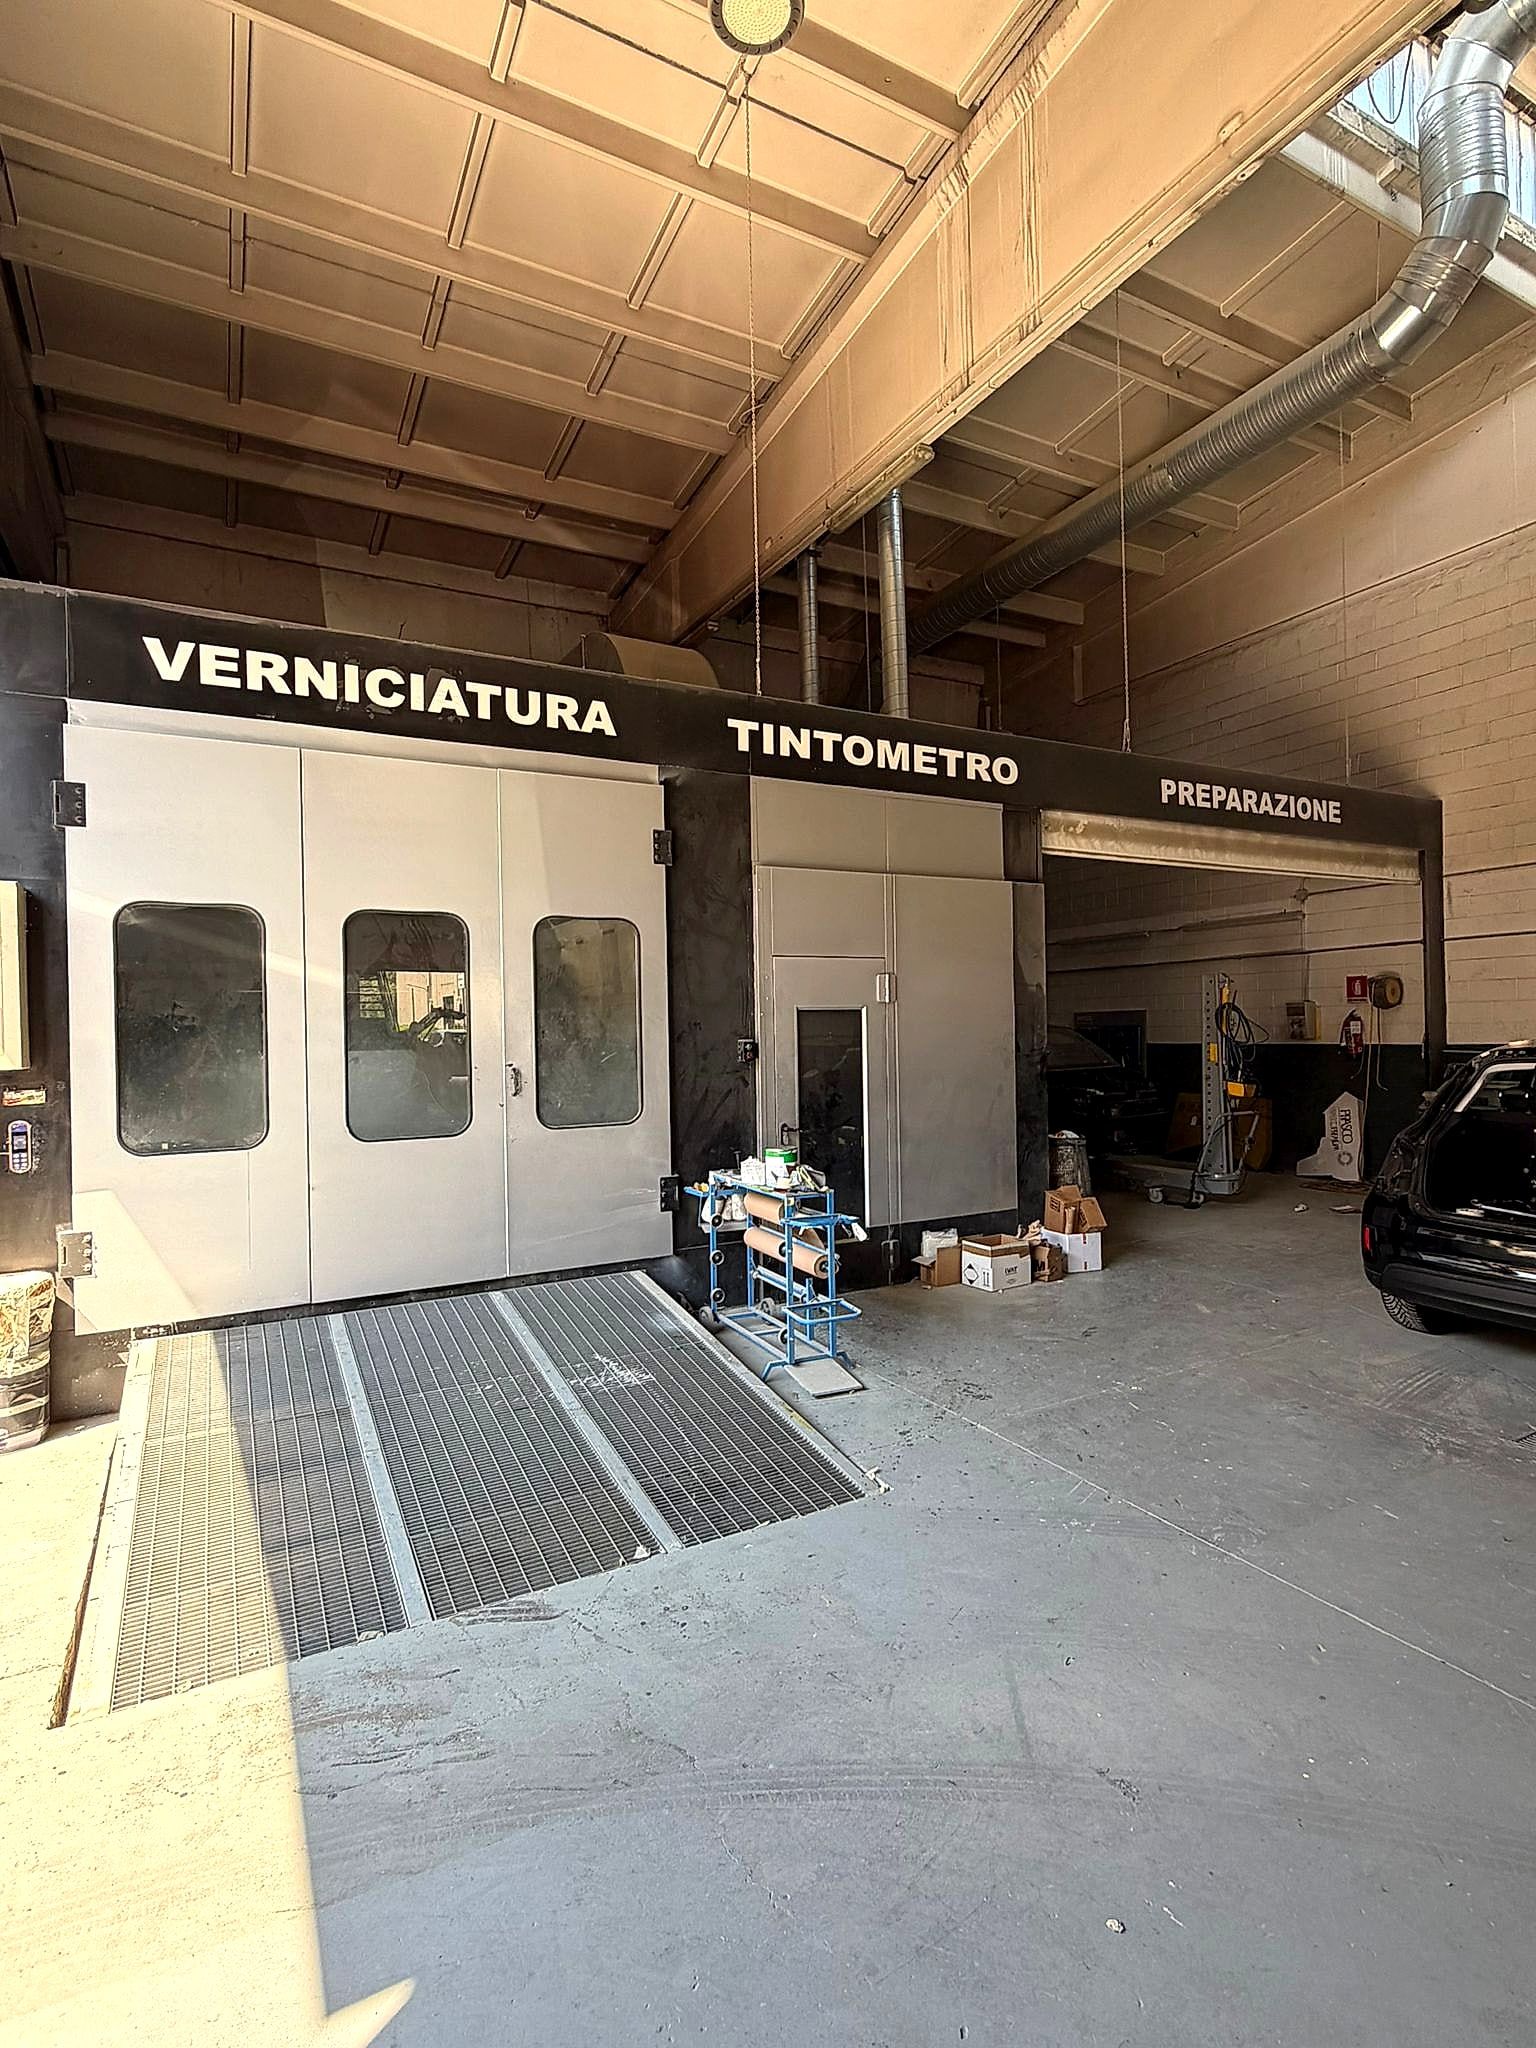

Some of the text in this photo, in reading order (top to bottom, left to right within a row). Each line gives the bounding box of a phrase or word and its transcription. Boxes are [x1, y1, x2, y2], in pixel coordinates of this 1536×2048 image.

[142, 636, 617, 737] VERNICIATURA
[727, 718, 1019, 785] TINTOMETRO
[1160, 778, 1342, 825] PREPARAZIONE
